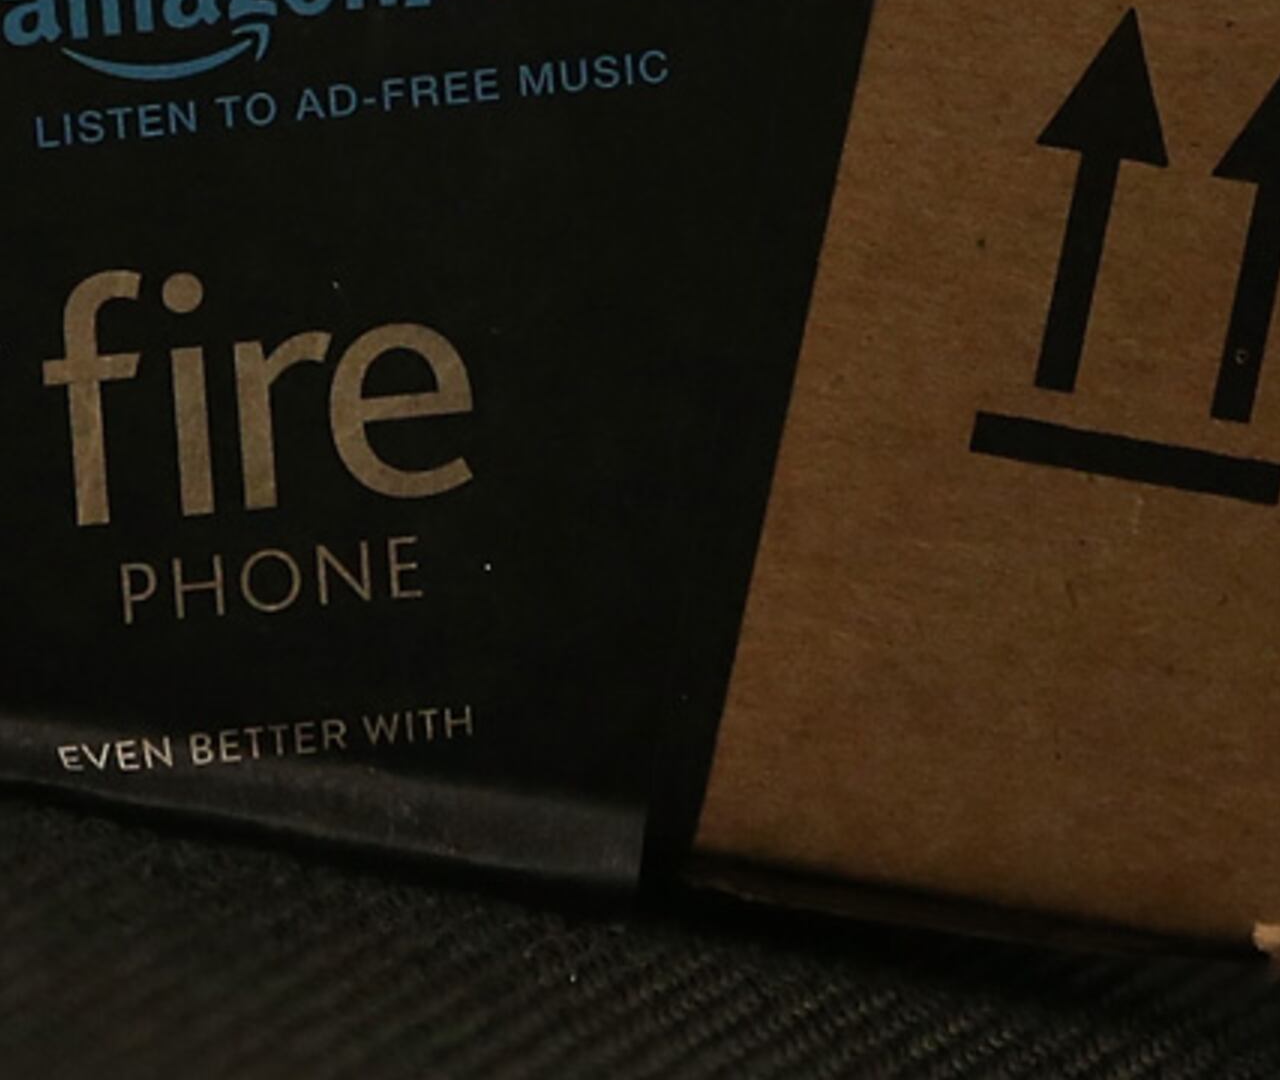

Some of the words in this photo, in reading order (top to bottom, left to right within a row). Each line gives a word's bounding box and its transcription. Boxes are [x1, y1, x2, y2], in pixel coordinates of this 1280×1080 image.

[34, 100, 198, 150] LISTEN
[214, 91, 277, 128] TO
[296, 67, 501, 122] AD-FREE
[518, 49, 670, 98] MUSIC
[42, 269, 474, 526] fire
[120, 535, 424, 624] PHONE
[58, 736, 174, 772] EVEN
[190, 718, 348, 766] BETTER
[361, 705, 474, 745] WITH
